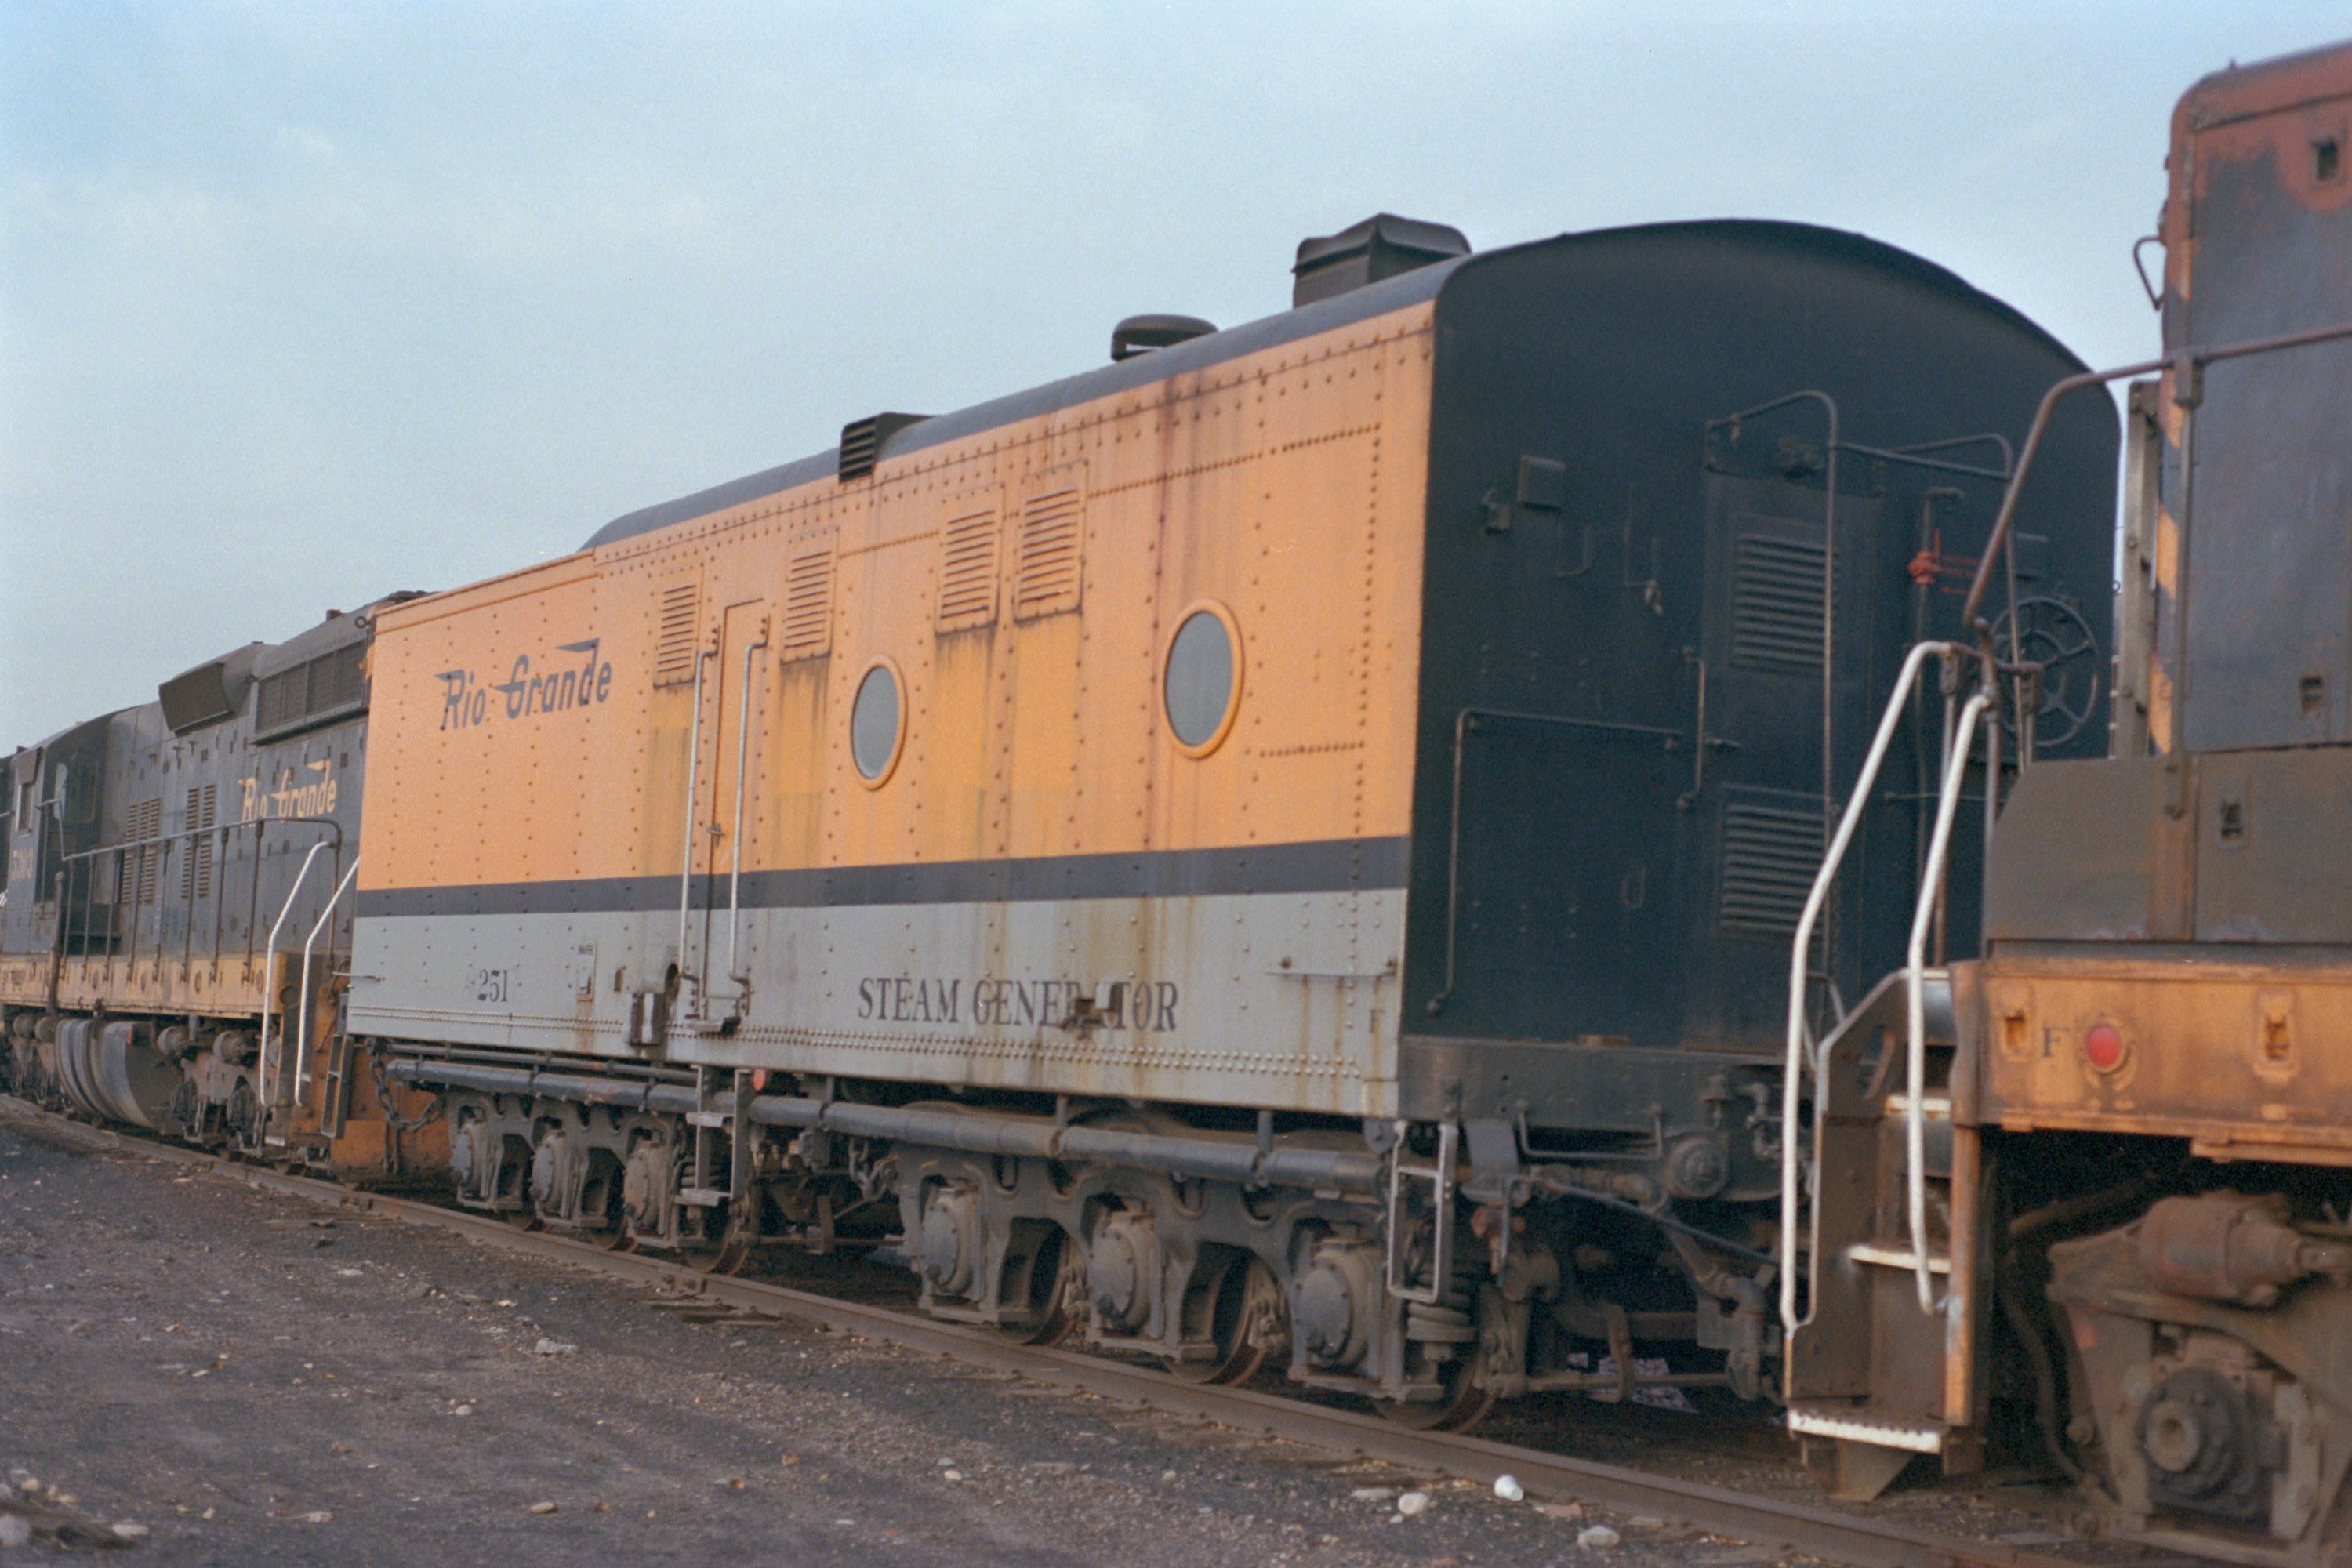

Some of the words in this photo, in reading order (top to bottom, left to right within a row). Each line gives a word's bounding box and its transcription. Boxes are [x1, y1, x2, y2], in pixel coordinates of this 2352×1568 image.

[434, 669, 486, 730] Rio
[492, 637, 612, 719] Grande
[238, 777, 268, 828] Rio
[270, 758, 337, 823] Grande
[477, 968, 509, 1003] 251
[857, 977, 961, 1024] STEAM
[972, 979, 1179, 1033] GENERTOR
[2042, 1026, 2070, 1058] F
